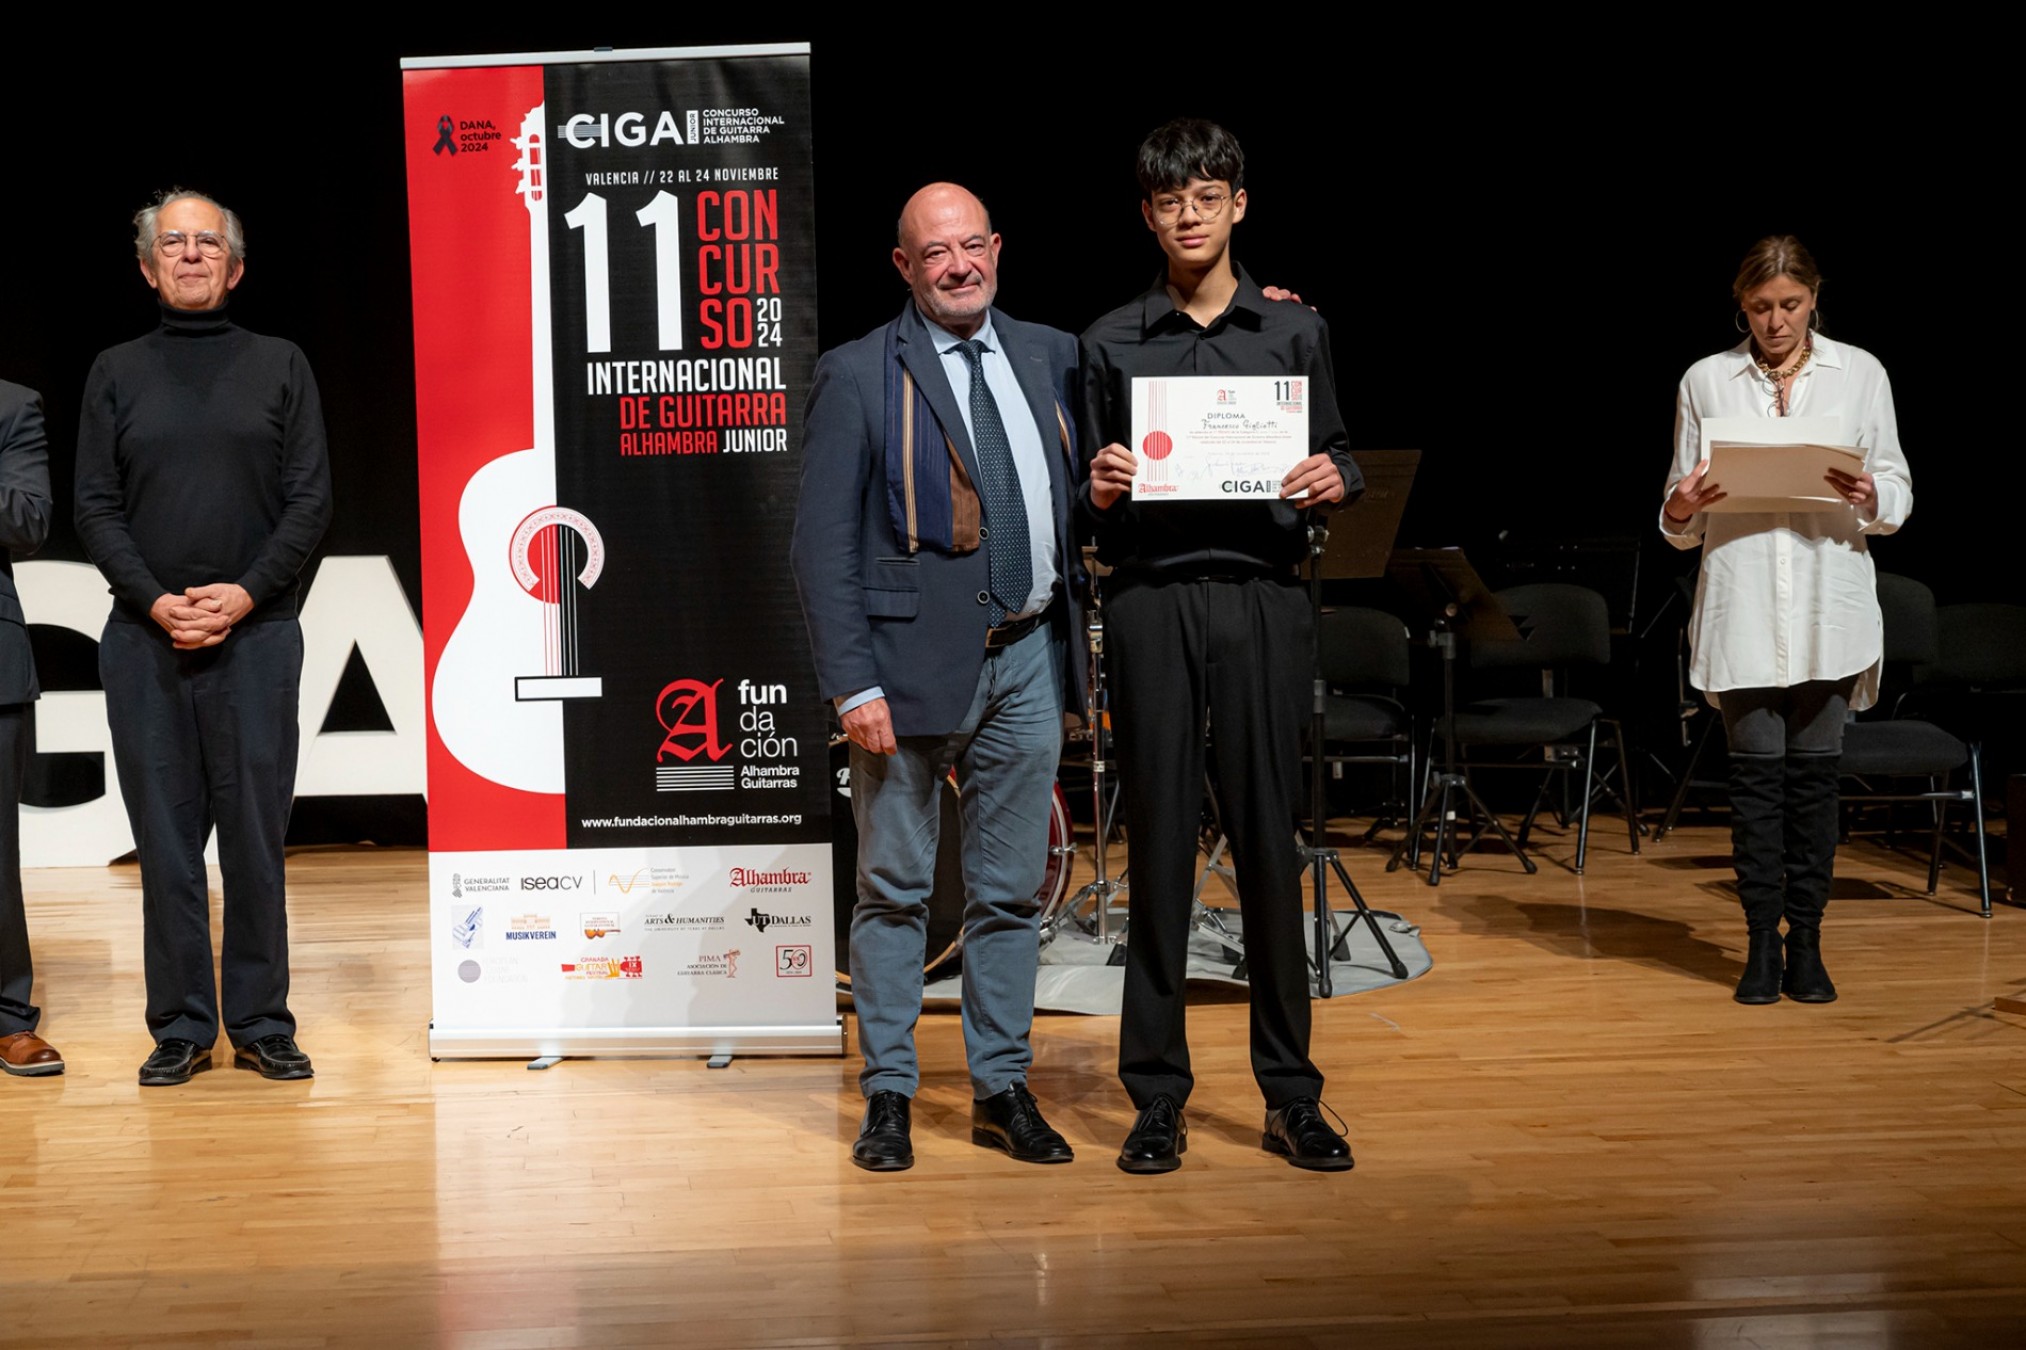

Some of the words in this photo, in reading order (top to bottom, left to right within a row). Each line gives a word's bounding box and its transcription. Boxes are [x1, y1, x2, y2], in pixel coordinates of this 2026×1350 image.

[702, 108, 760, 117] CONCURSO
[460, 120, 496, 130] DANA,
[689, 113, 697, 143] JUNIOR
[702, 116, 785, 126] INTERNACIONAL
[460, 131, 502, 142] octubre
[565, 110, 685, 149] CIGA
[702, 126, 717, 135] DE
[719, 126, 771, 135] GUITARRA
[703, 135, 761, 144] ALHAMBRA
[460, 142, 489, 153] 2024
[585, 171, 640, 186] VALENCIA
[659, 170, 675, 184] 22
[678, 170, 692, 183] AL
[695, 169, 711, 182] 24
[714, 167, 779, 182] NOVIEMBRE
[696, 189, 778, 242] CON
[564, 190, 683, 353] 11
[698, 243, 781, 296] CUR
[756, 297, 782, 323] 20
[699, 297, 754, 350] SO
[757, 322, 783, 348] 24
[587, 357, 787, 395] INTERNACIONAL
[1274, 380, 1290, 401] 11
[619, 396, 651, 430] DE
[658, 392, 788, 429] GUITARRA
[1206, 412, 1246, 420] DIPLOMA
[620, 430, 719, 457] ALHAMBRA
[722, 428, 788, 454] JUNIOR
[1221, 480, 1265, 494] CIGA
[738, 679, 788, 705] fun
[739, 705, 776, 732] da
[740, 731, 799, 759] ción
[740, 764, 800, 778] Alhambra
[741, 776, 798, 790] Guitarras
[581, 813, 803, 828] www.fundacionalhambraguitarras.org
[464, 877, 510, 885] GENERALITAT
[729, 866, 812, 889] Alhambra
[465, 884, 510, 892] VALENCIANA
[644, 918, 664, 926] ARTS
[663, 912, 676, 925] &
[675, 916, 725, 925] HUMANITIES
[771, 915, 812, 925] DALLAS
[505, 931, 557, 941] MUSIKVEREIN
[698, 955, 722, 963] PIMA
